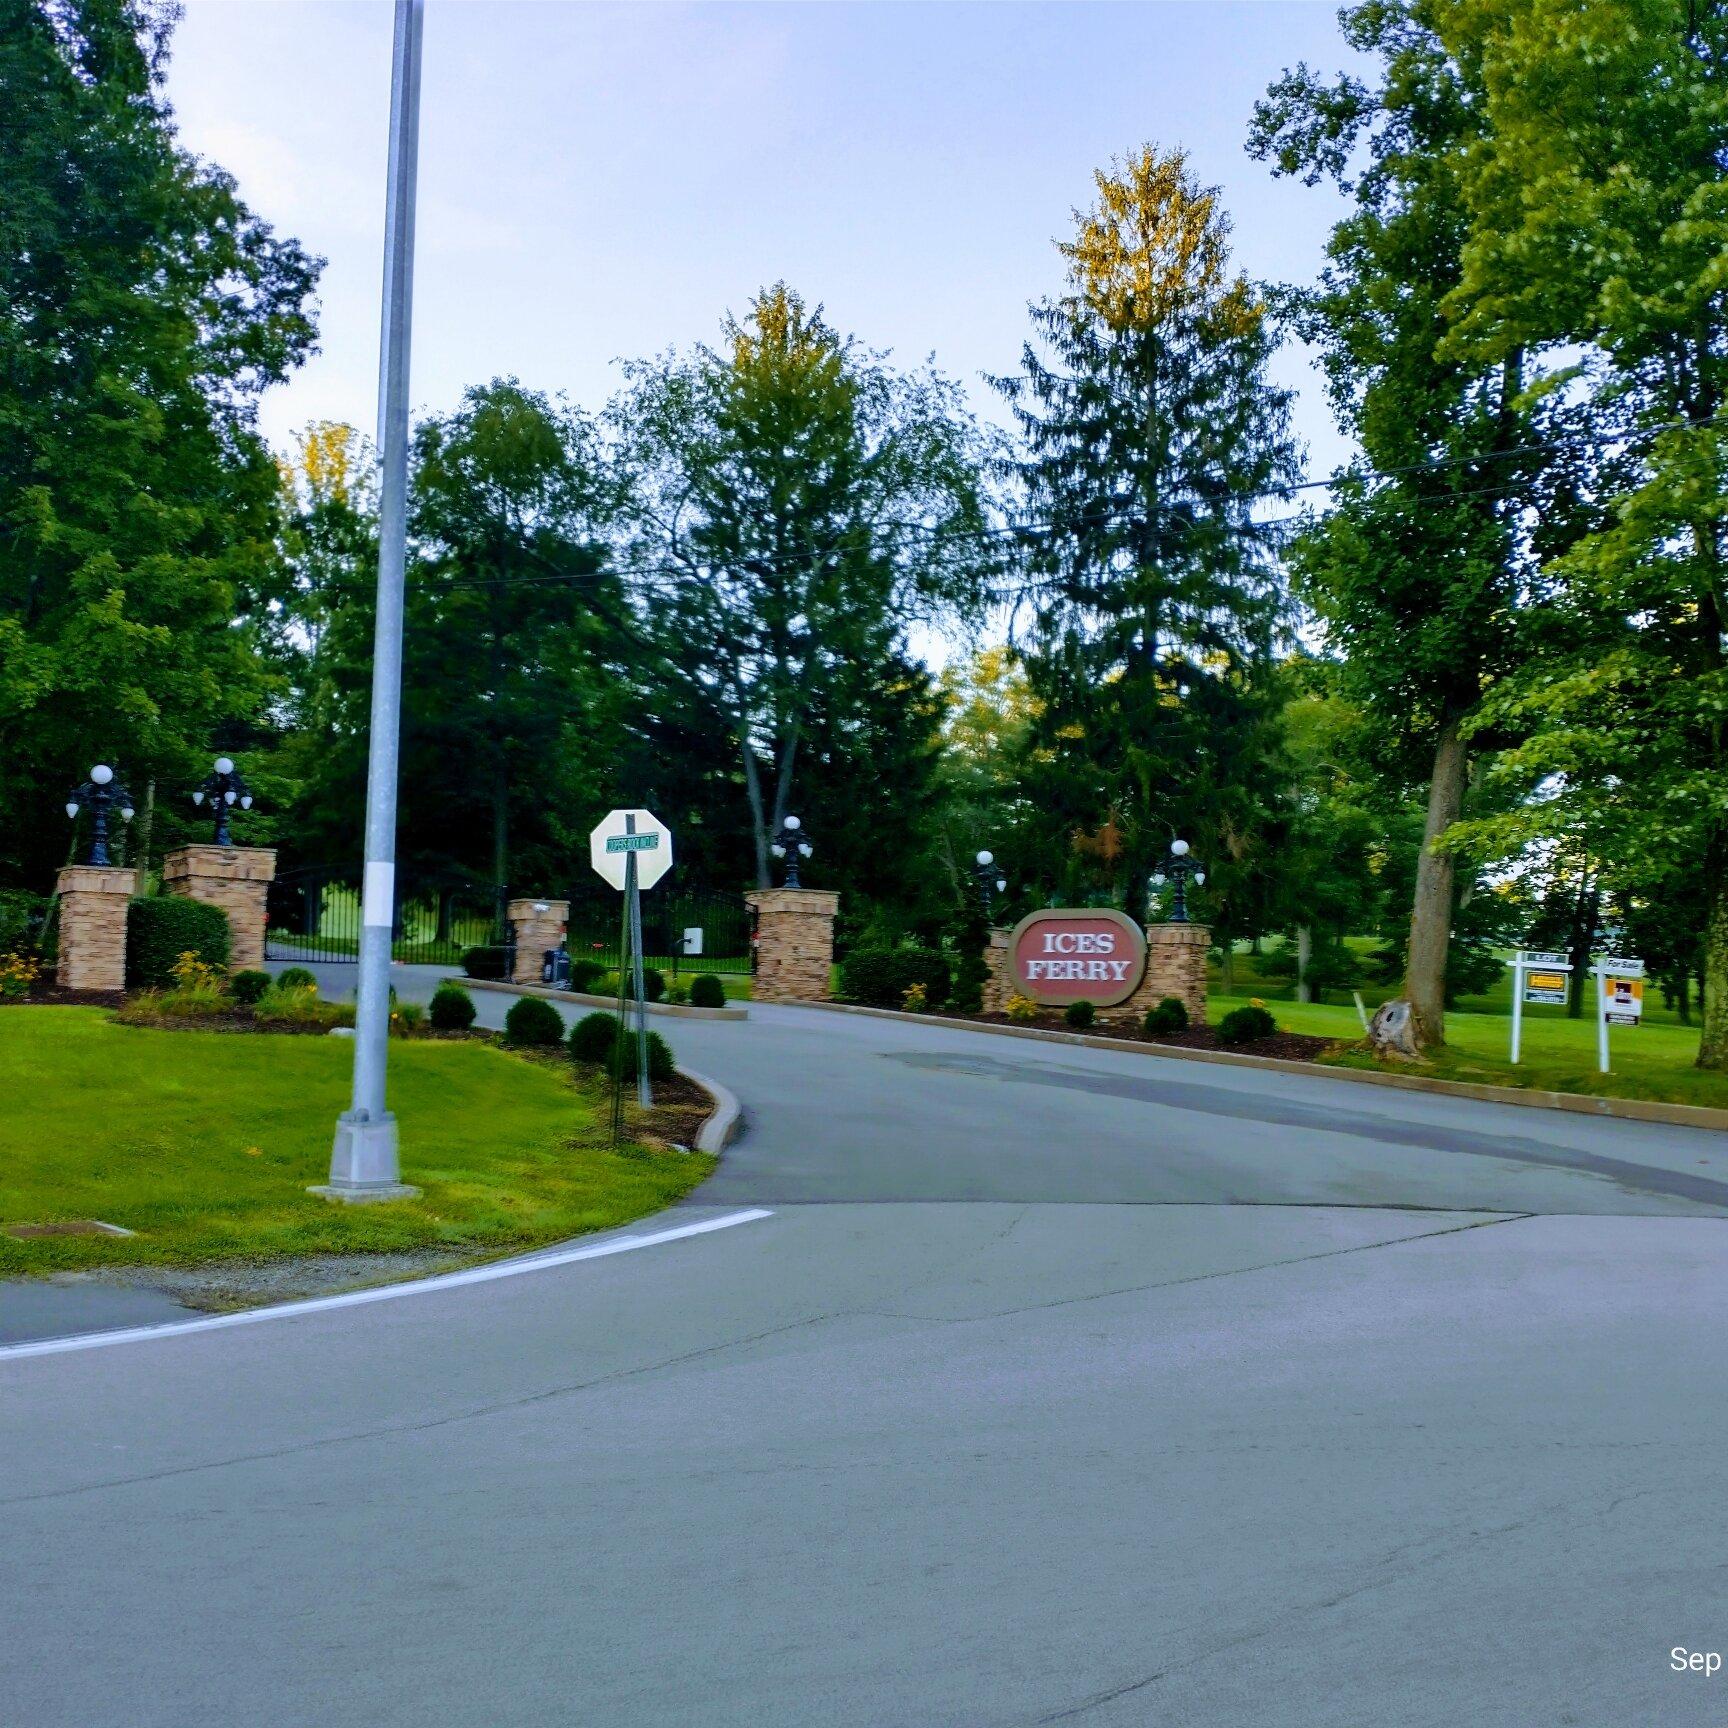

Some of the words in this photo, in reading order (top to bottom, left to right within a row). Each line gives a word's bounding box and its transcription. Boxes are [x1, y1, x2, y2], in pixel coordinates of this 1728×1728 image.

[1043, 933, 1115, 954] ICES
[1535, 954, 1559, 962] LOT
[1608, 959, 1620, 968] For
[1621, 961, 1639, 970] Sale
[1026, 960, 1132, 981] FERRY
